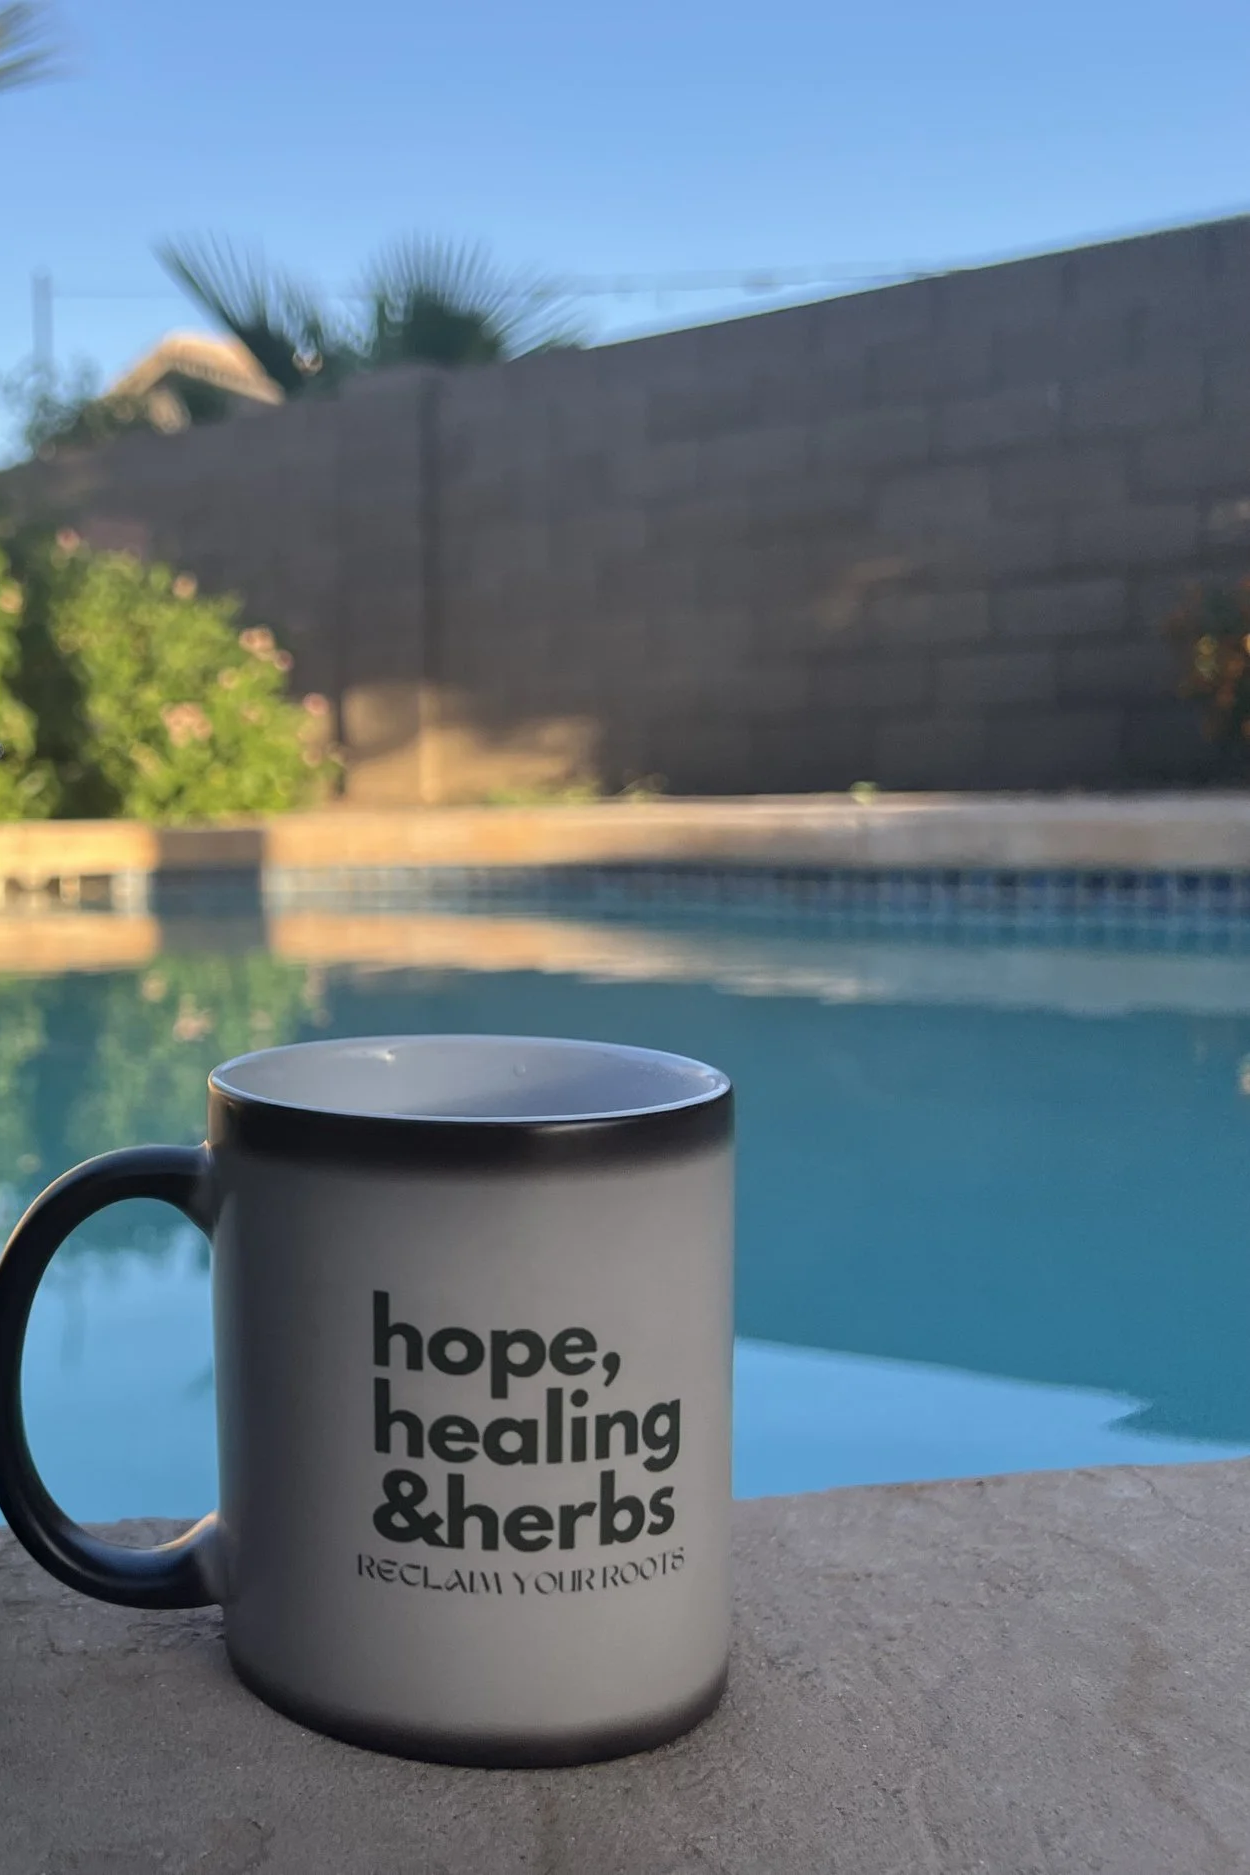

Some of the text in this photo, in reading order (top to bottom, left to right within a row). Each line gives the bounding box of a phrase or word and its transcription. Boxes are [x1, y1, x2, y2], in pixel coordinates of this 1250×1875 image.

[373, 1290, 621, 1400] hope,
[374, 1377, 681, 1473] healing
[372, 1469, 676, 1553] &herbs
[357, 1546, 685, 1595] RECLAIM YOUR ROOTS
